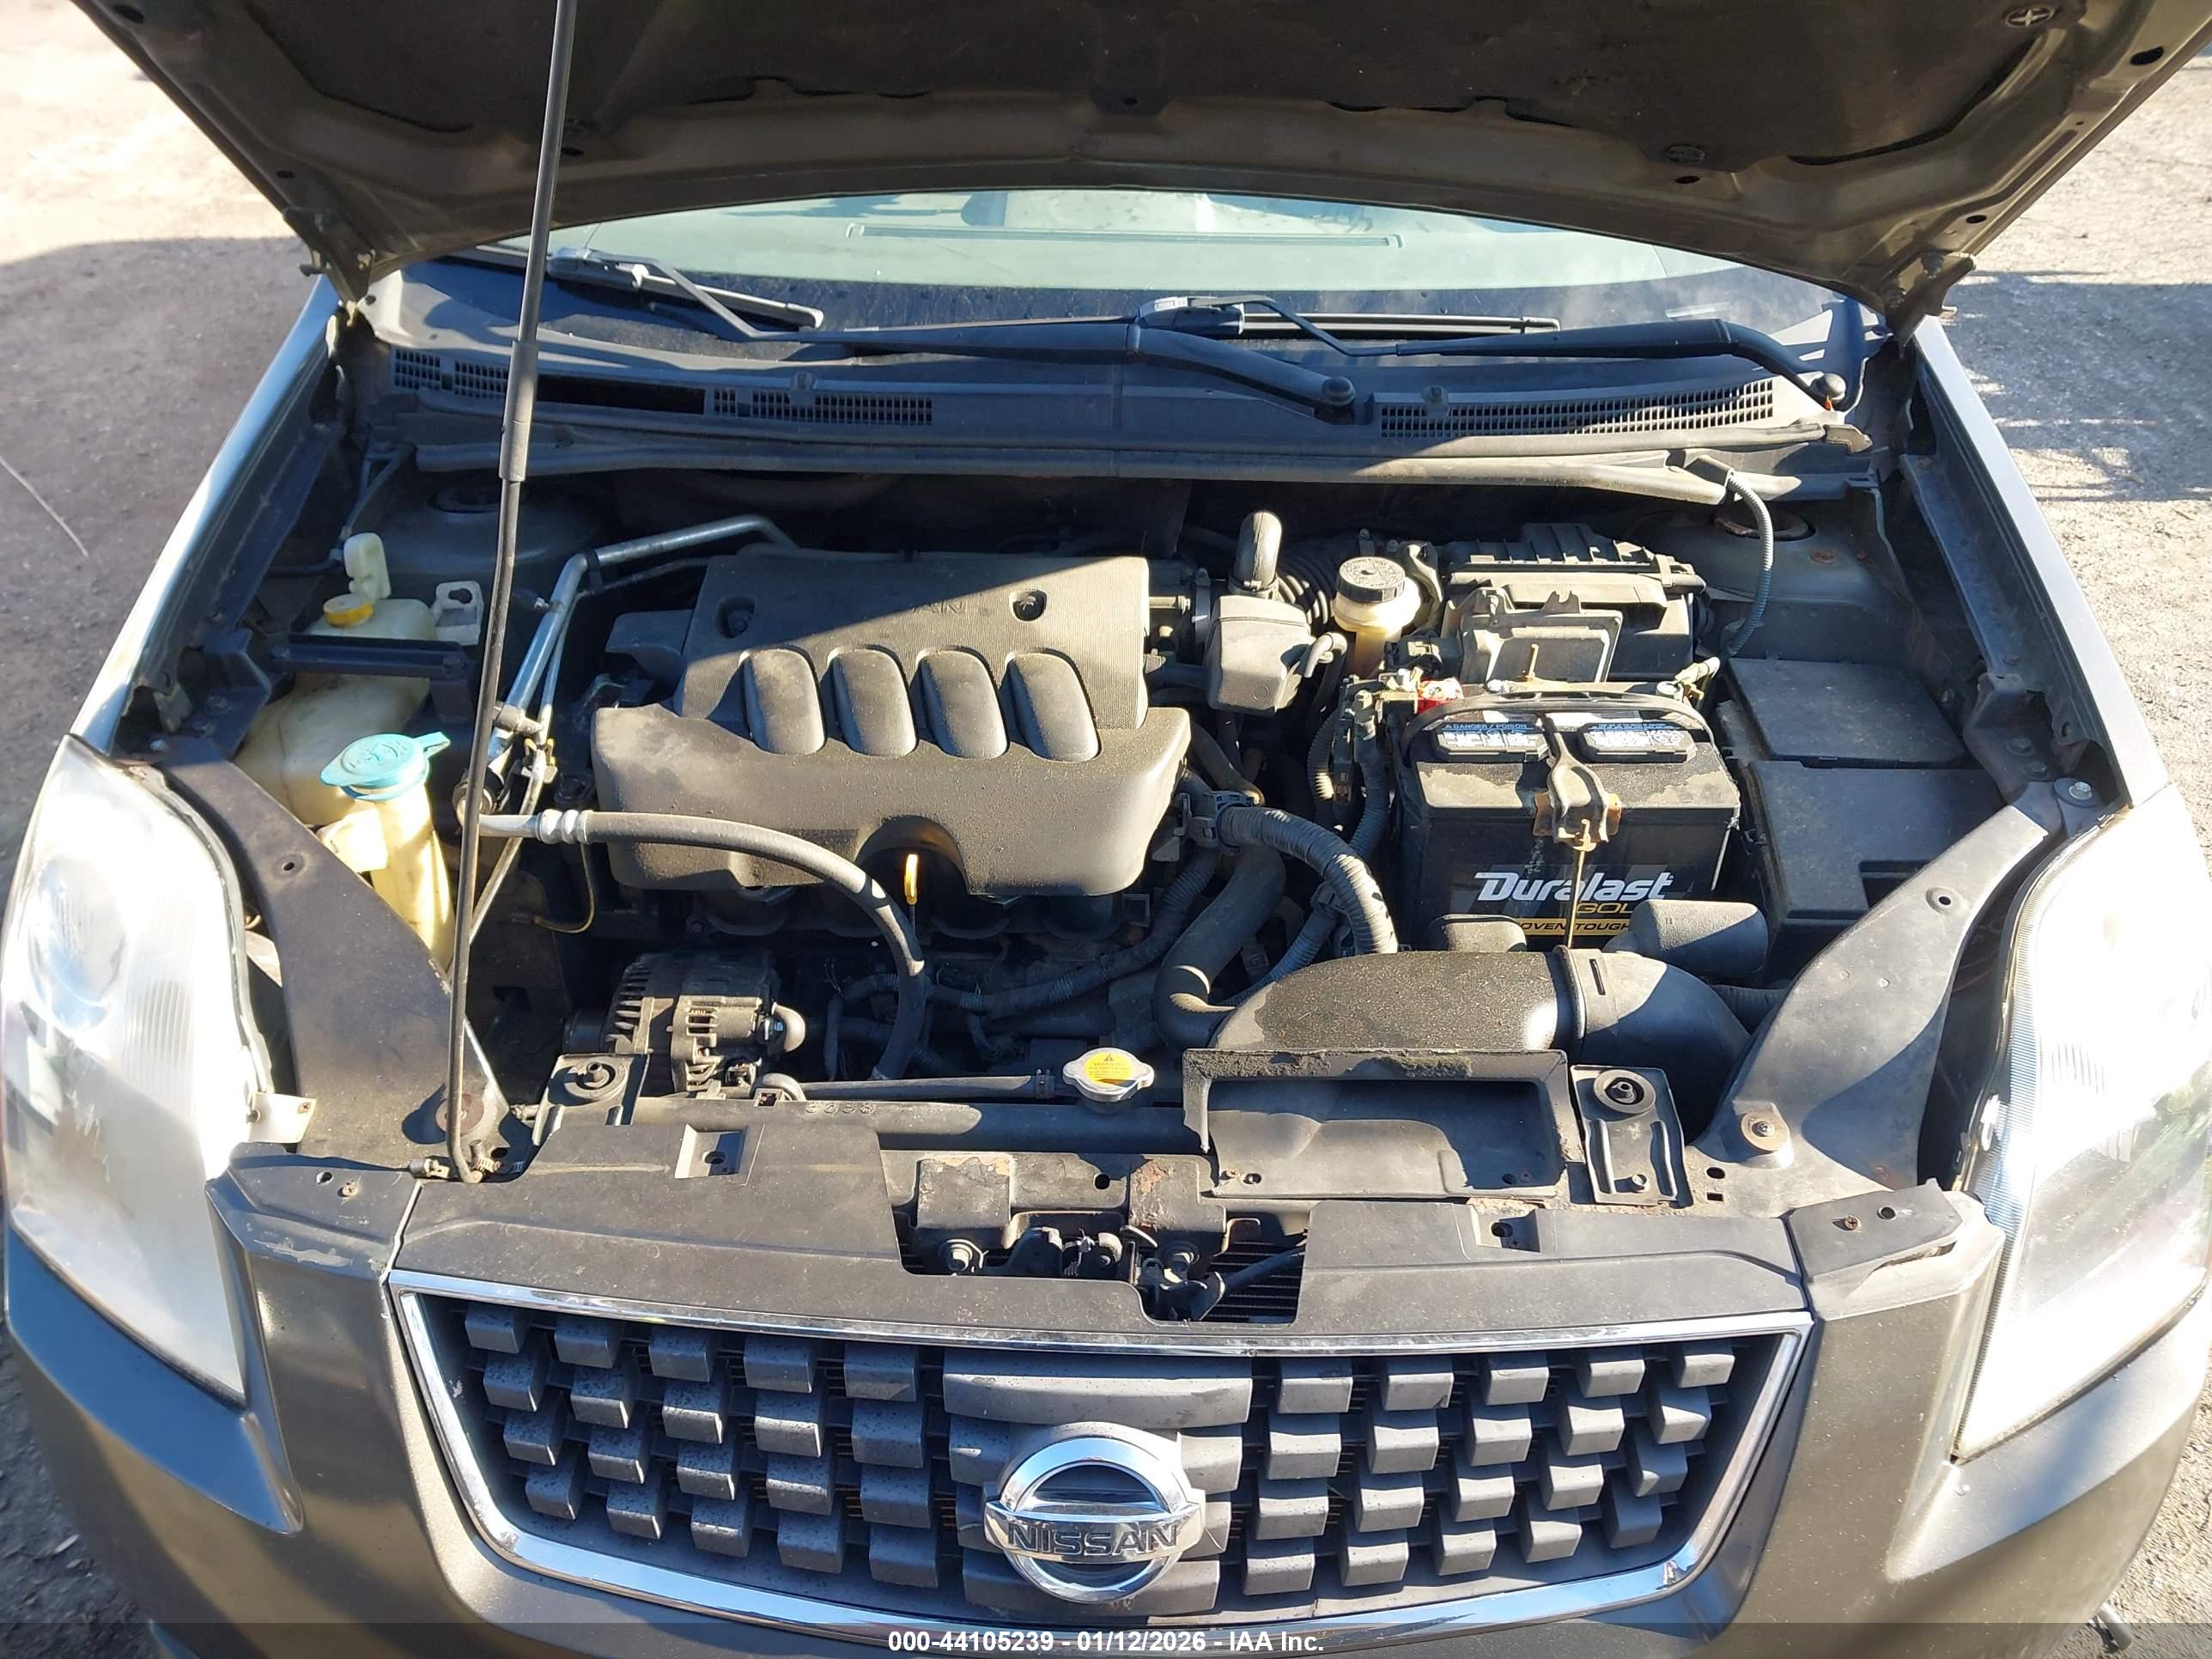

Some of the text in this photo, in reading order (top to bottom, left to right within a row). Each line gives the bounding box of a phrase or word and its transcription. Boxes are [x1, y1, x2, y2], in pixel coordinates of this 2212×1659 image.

[1474, 872, 1674, 902] Duralast
[1576, 902, 1633, 914] GOL
[1007, 1522, 1178, 1557] NISSAN
